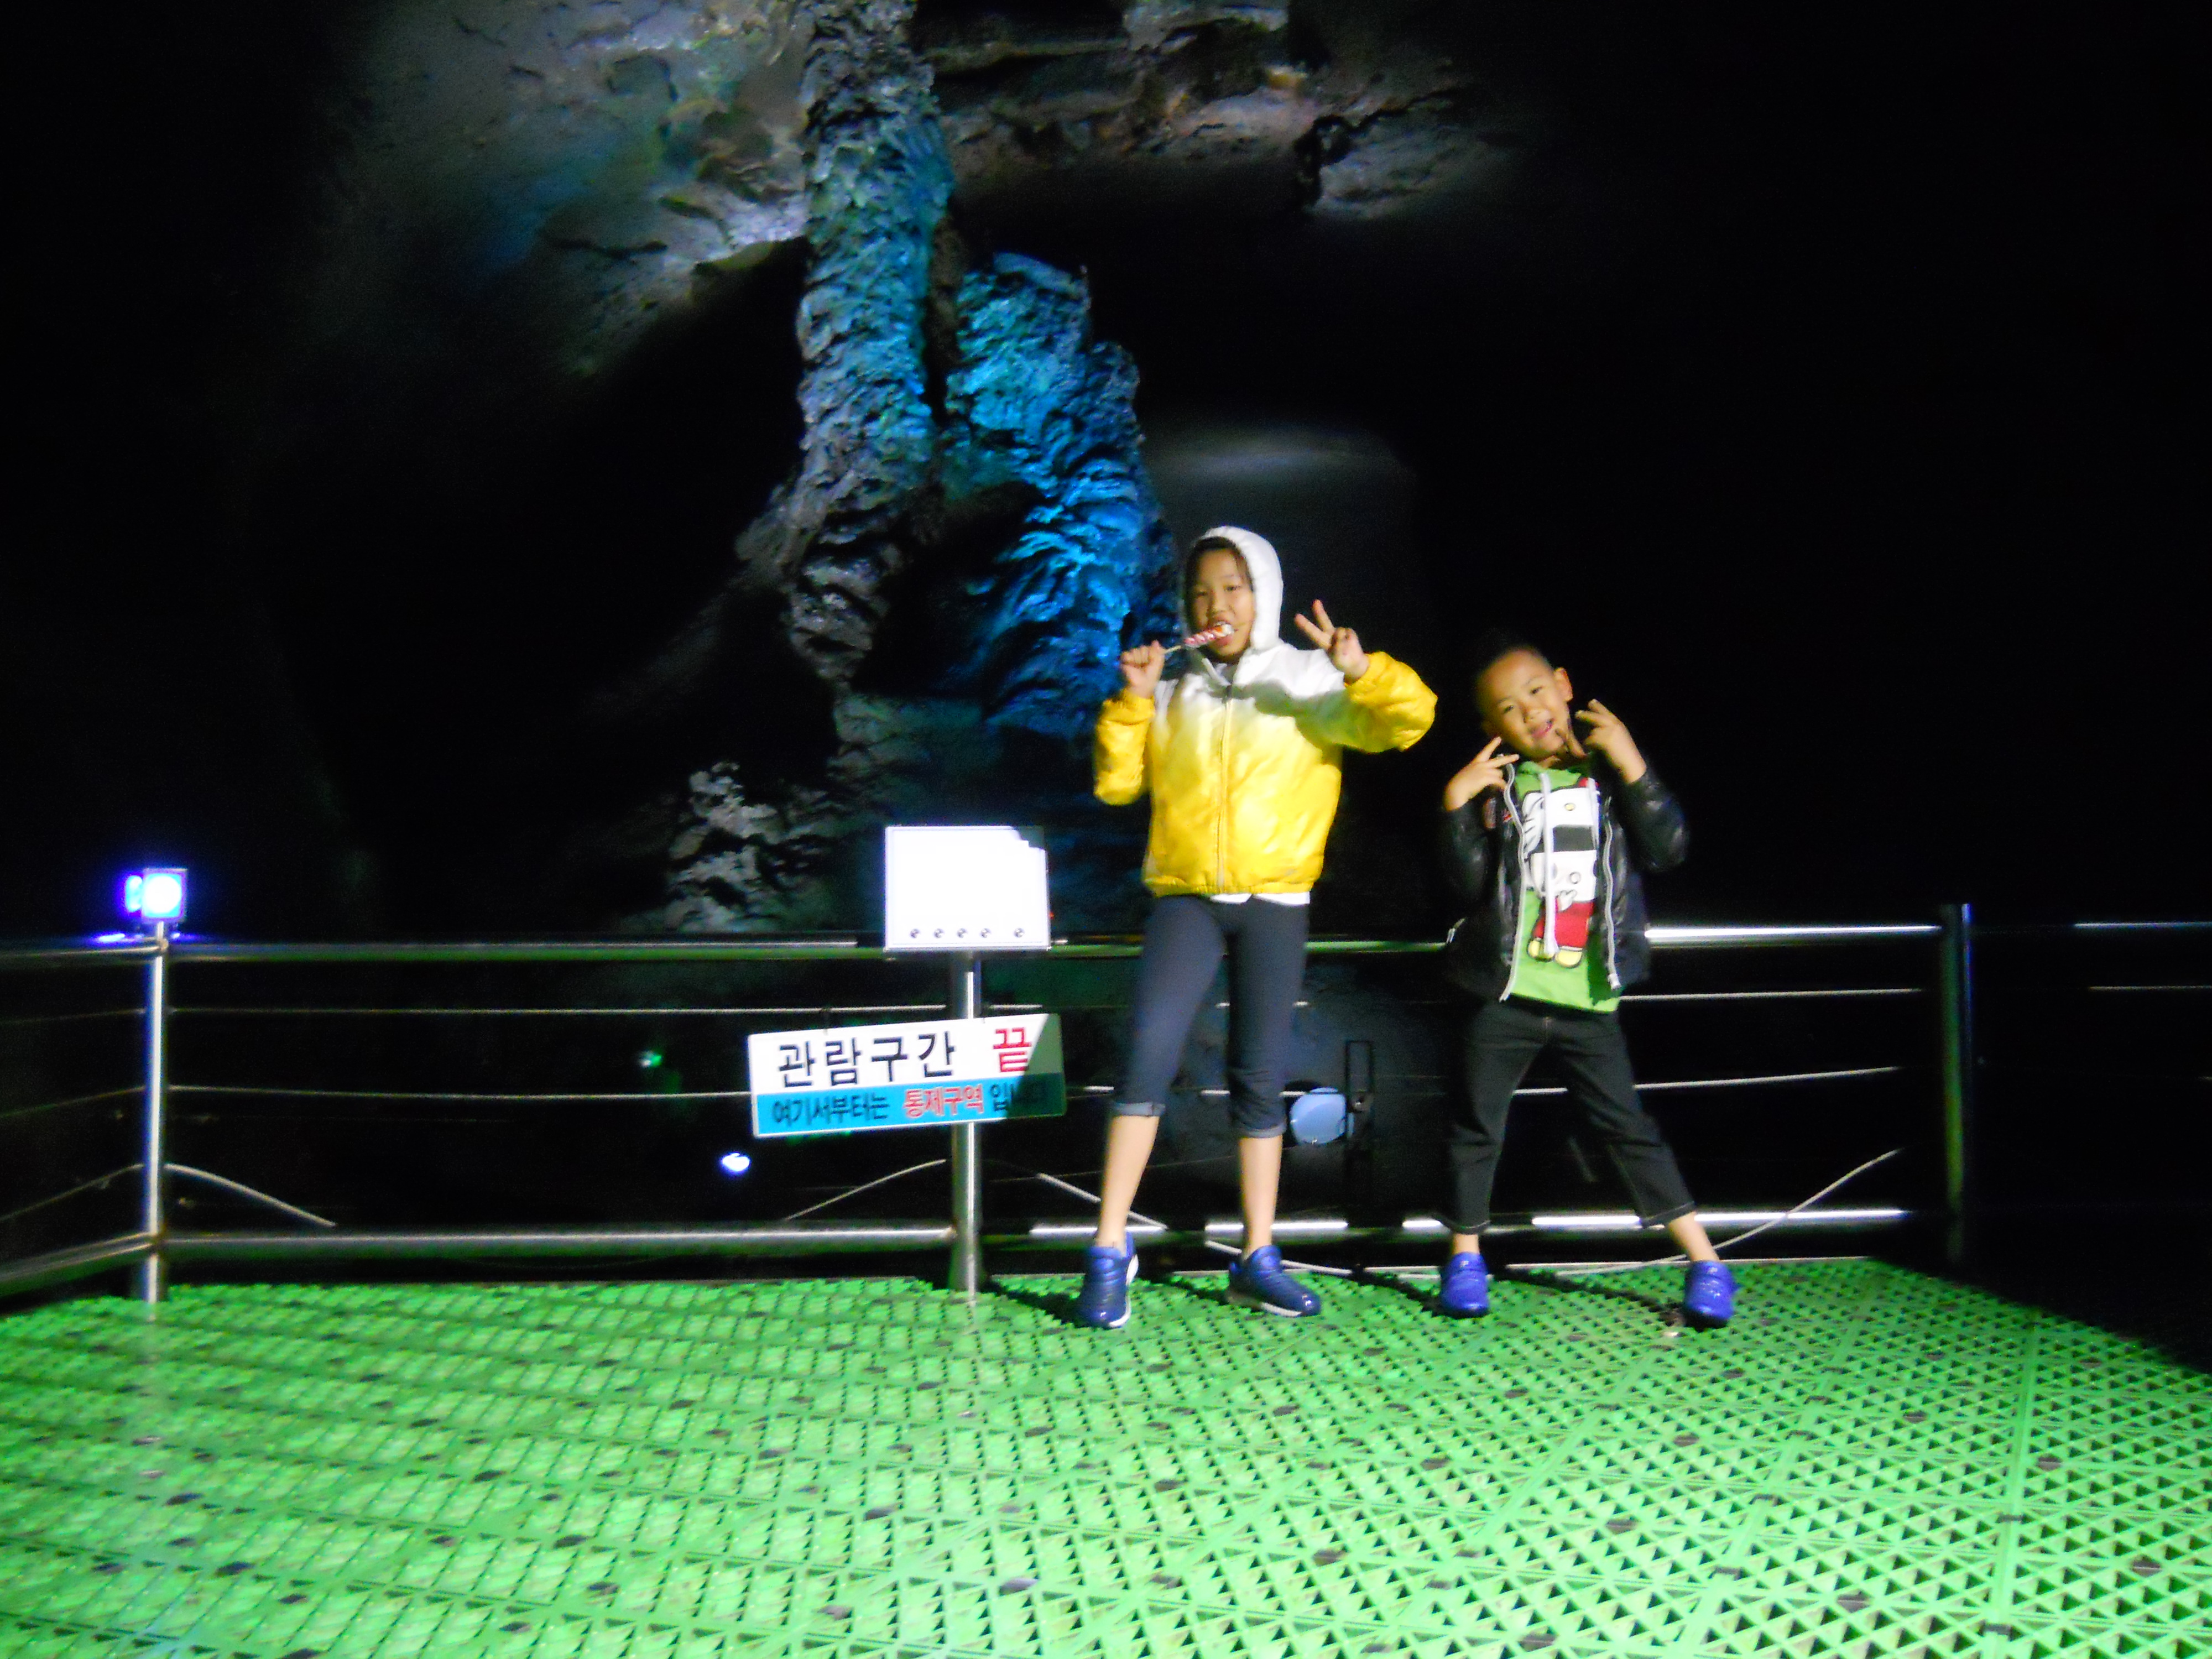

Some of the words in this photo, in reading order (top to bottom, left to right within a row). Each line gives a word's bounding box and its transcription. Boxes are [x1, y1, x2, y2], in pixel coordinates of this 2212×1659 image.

[778, 1030, 956, 1088] 관람구간
[993, 1027, 1032, 1073] 끝
[772, 1093, 890, 1127] 여기서부터는
[902, 1083, 985, 1119] 통제구역
